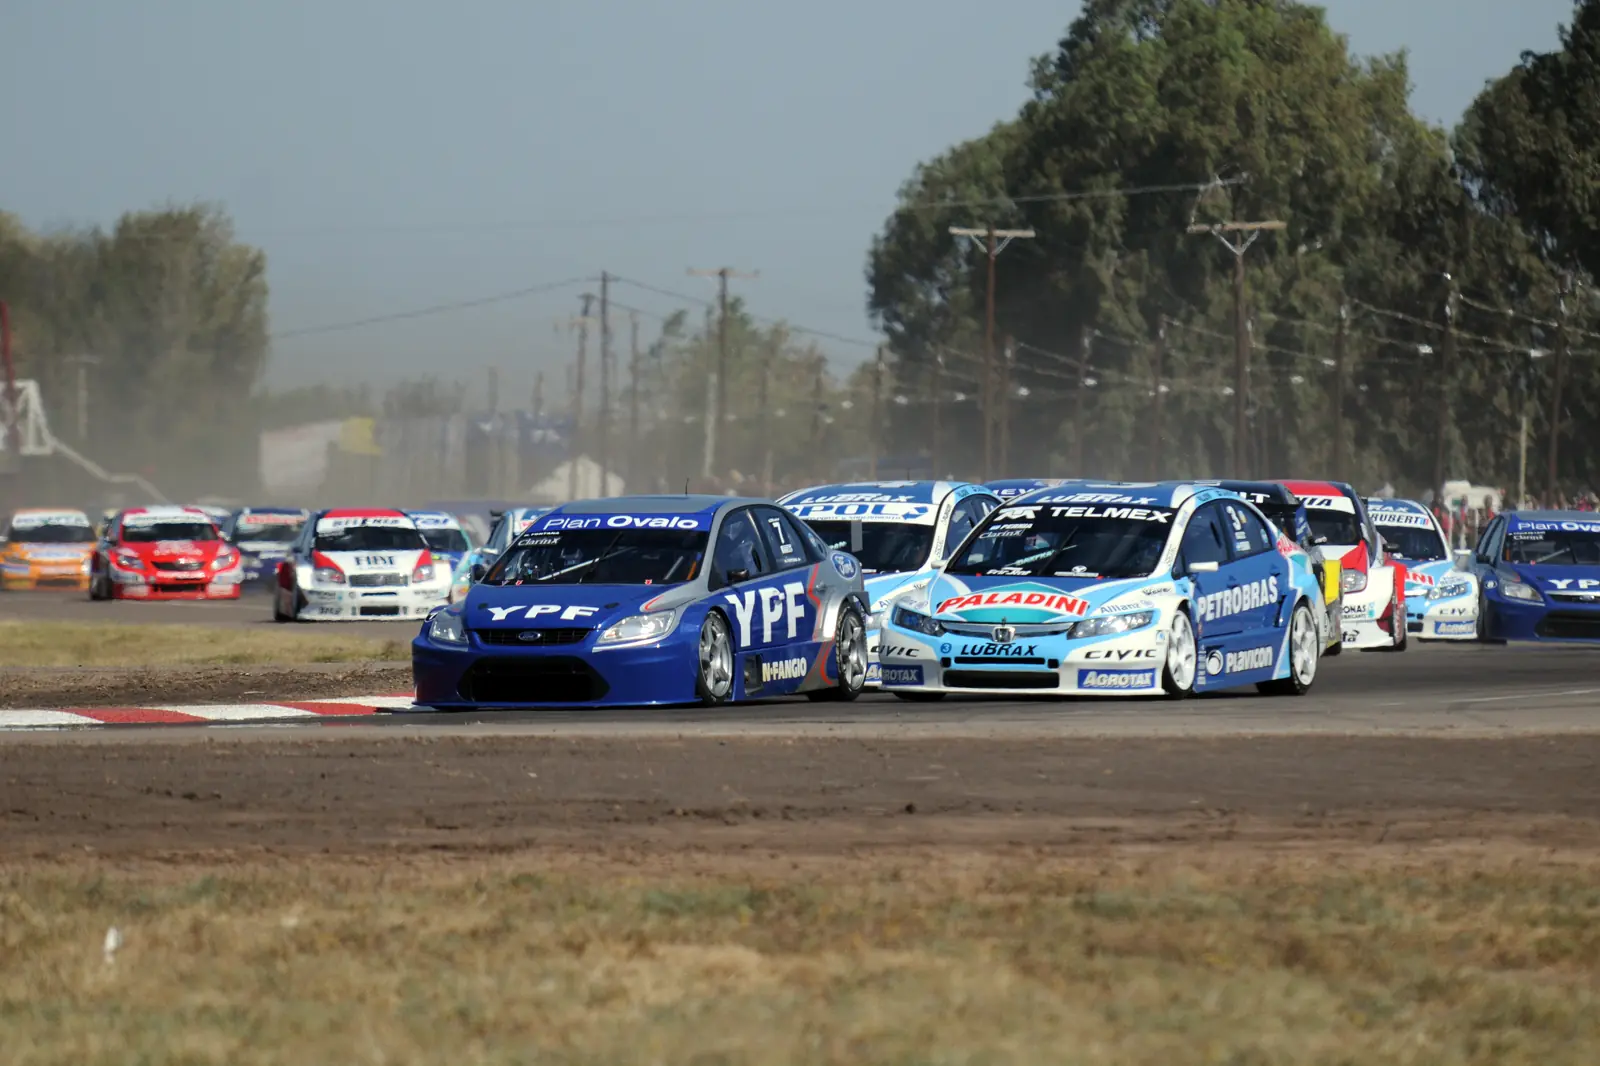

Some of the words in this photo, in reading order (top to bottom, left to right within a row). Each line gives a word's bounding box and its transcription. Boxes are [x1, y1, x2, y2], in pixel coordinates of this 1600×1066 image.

[801, 493, 915, 503] LUBRAX
[1036, 493, 1158, 504] LUBRAX
[543, 516, 600, 530] Plan
[607, 515, 699, 529] Ovalo
[1050, 506, 1173, 523] TELMEX
[1225, 506, 1241, 530] 3
[772, 522, 785, 544] 7
[1518, 522, 1559, 530] Plan
[937, 592, 1089, 616] PALADINI
[1197, 575, 1279, 622] PETROBRAS
[488, 604, 600, 621] YPF
[724, 582, 806, 648] YPF
[960, 643, 1038, 656] LUBRAX
[1084, 649, 1157, 660] CIVIC
[1083, 670, 1153, 687] AGROTAX
